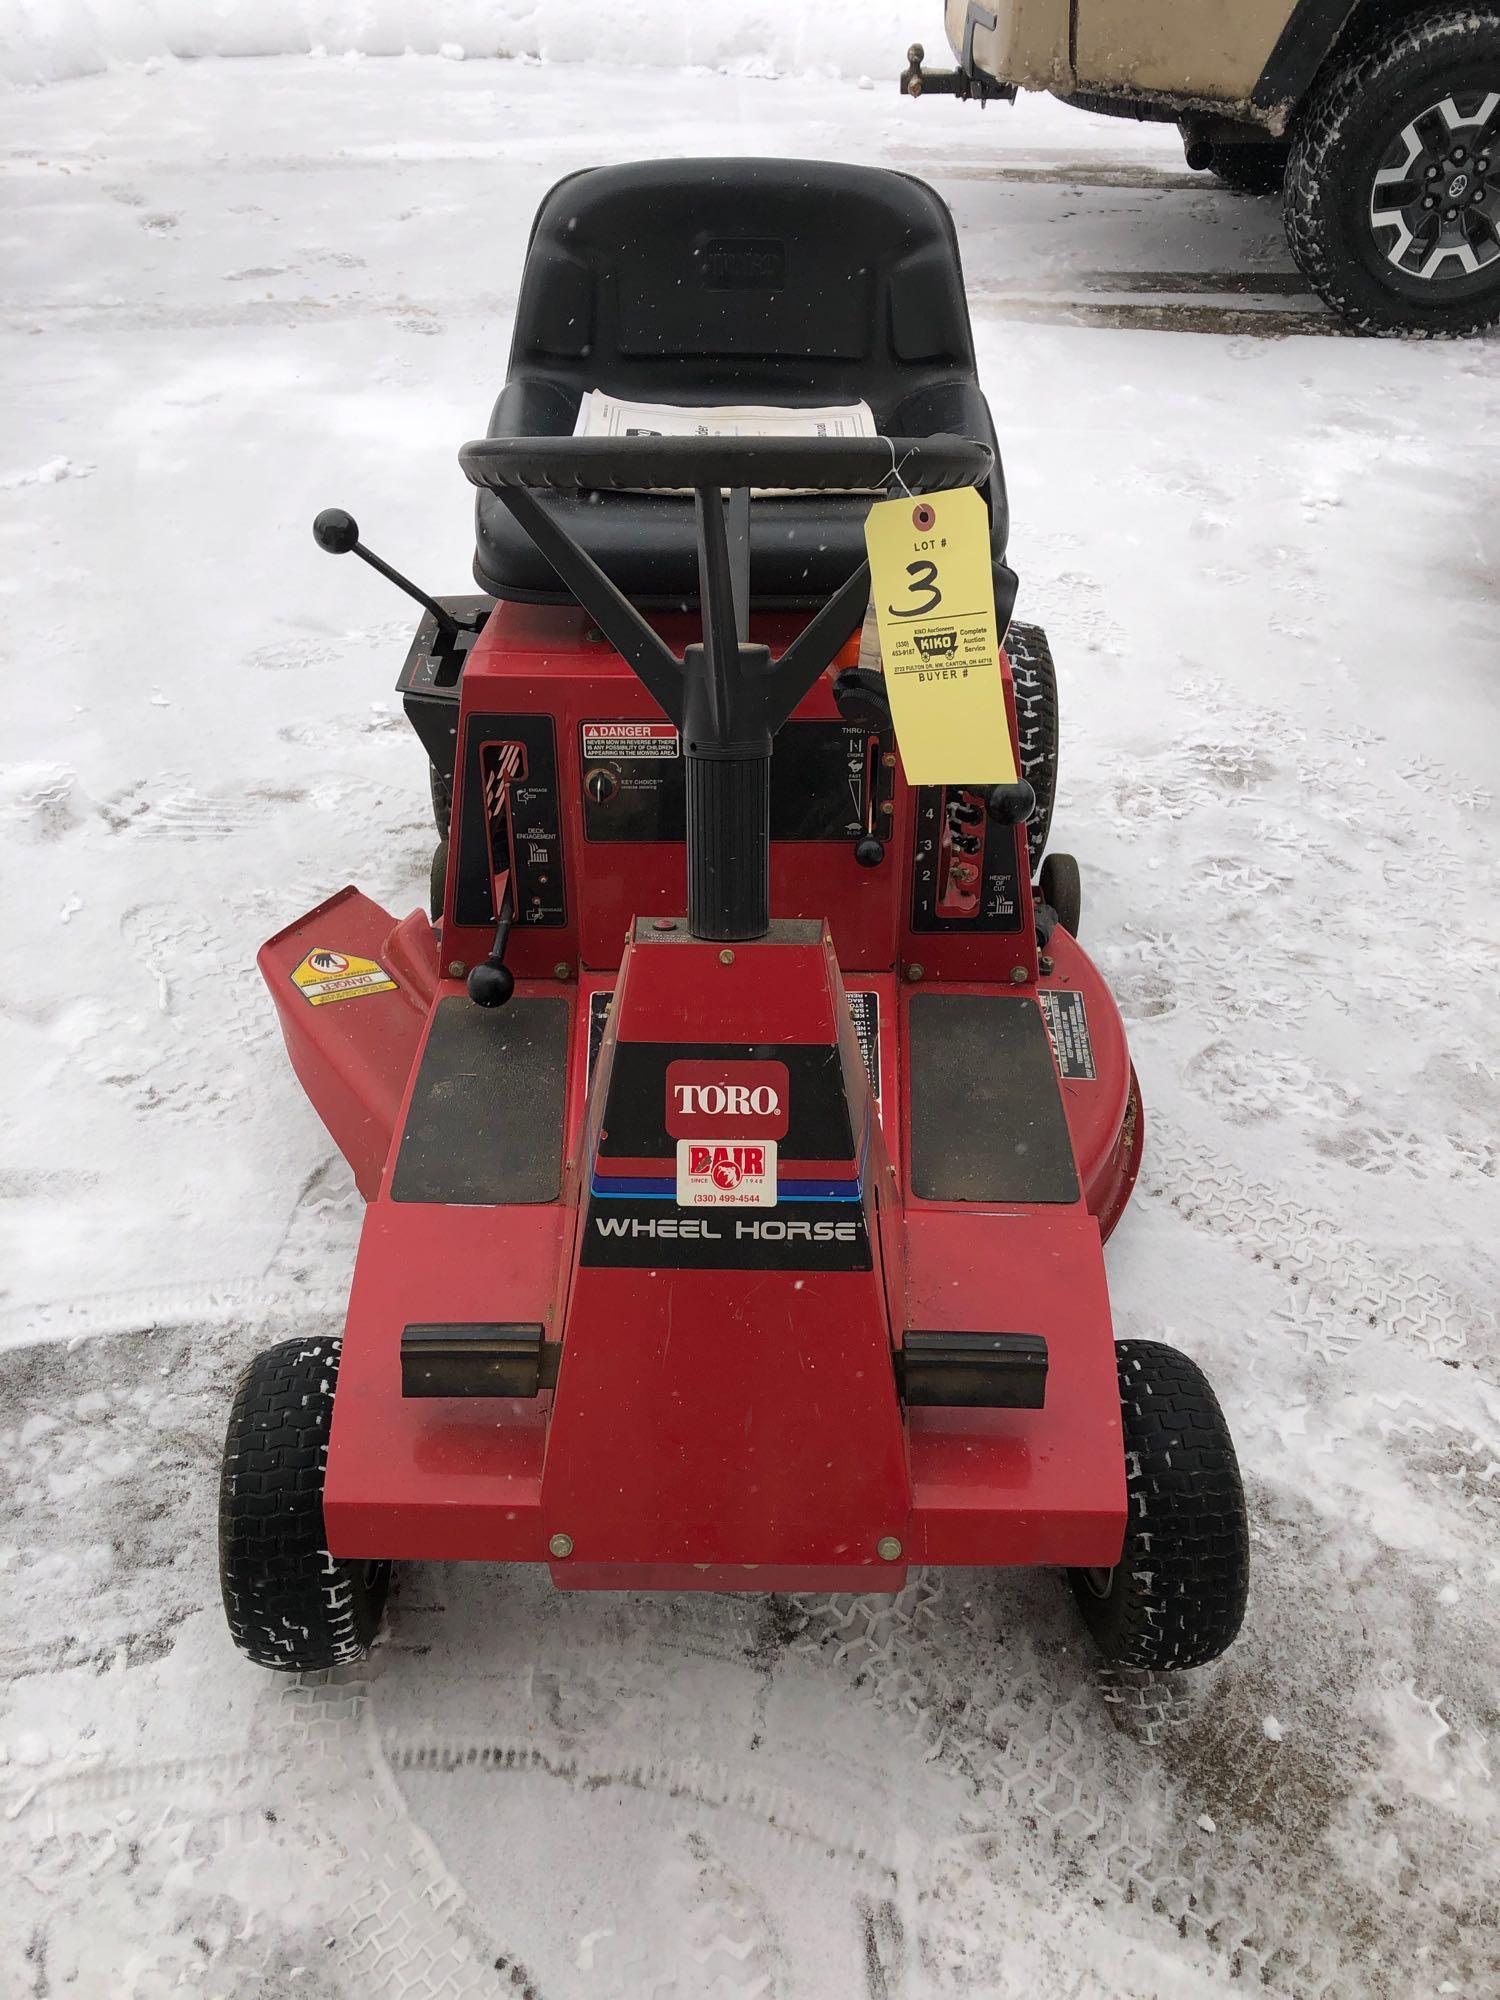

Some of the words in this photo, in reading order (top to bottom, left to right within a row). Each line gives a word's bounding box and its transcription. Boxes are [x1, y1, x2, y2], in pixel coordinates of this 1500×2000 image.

[914, 541, 935, 551] LOT
[941, 538, 947, 548] #
[888, 560, 942, 617] 3
[960, 627, 987, 636] Complete
[921, 637, 951, 650] KIKO
[963, 636, 986, 644] Auction
[918, 669, 958, 682] BUYER
[962, 669, 969, 678] #
[600, 727, 651, 737] DANGER
[926, 808, 934, 819] 4
[924, 840, 932, 851] 3
[922, 871, 931, 881] 2
[921, 900, 928, 911] 1
[321, 975, 373, 991] DANGER
[690, 1147, 763, 1174] BAIR
[694, 1194, 717, 1204] (330)
[719, 1194, 760, 1203] 499-4544
[596, 1218, 722, 1239] WHEEL
[735, 1221, 857, 1241] HORSE
